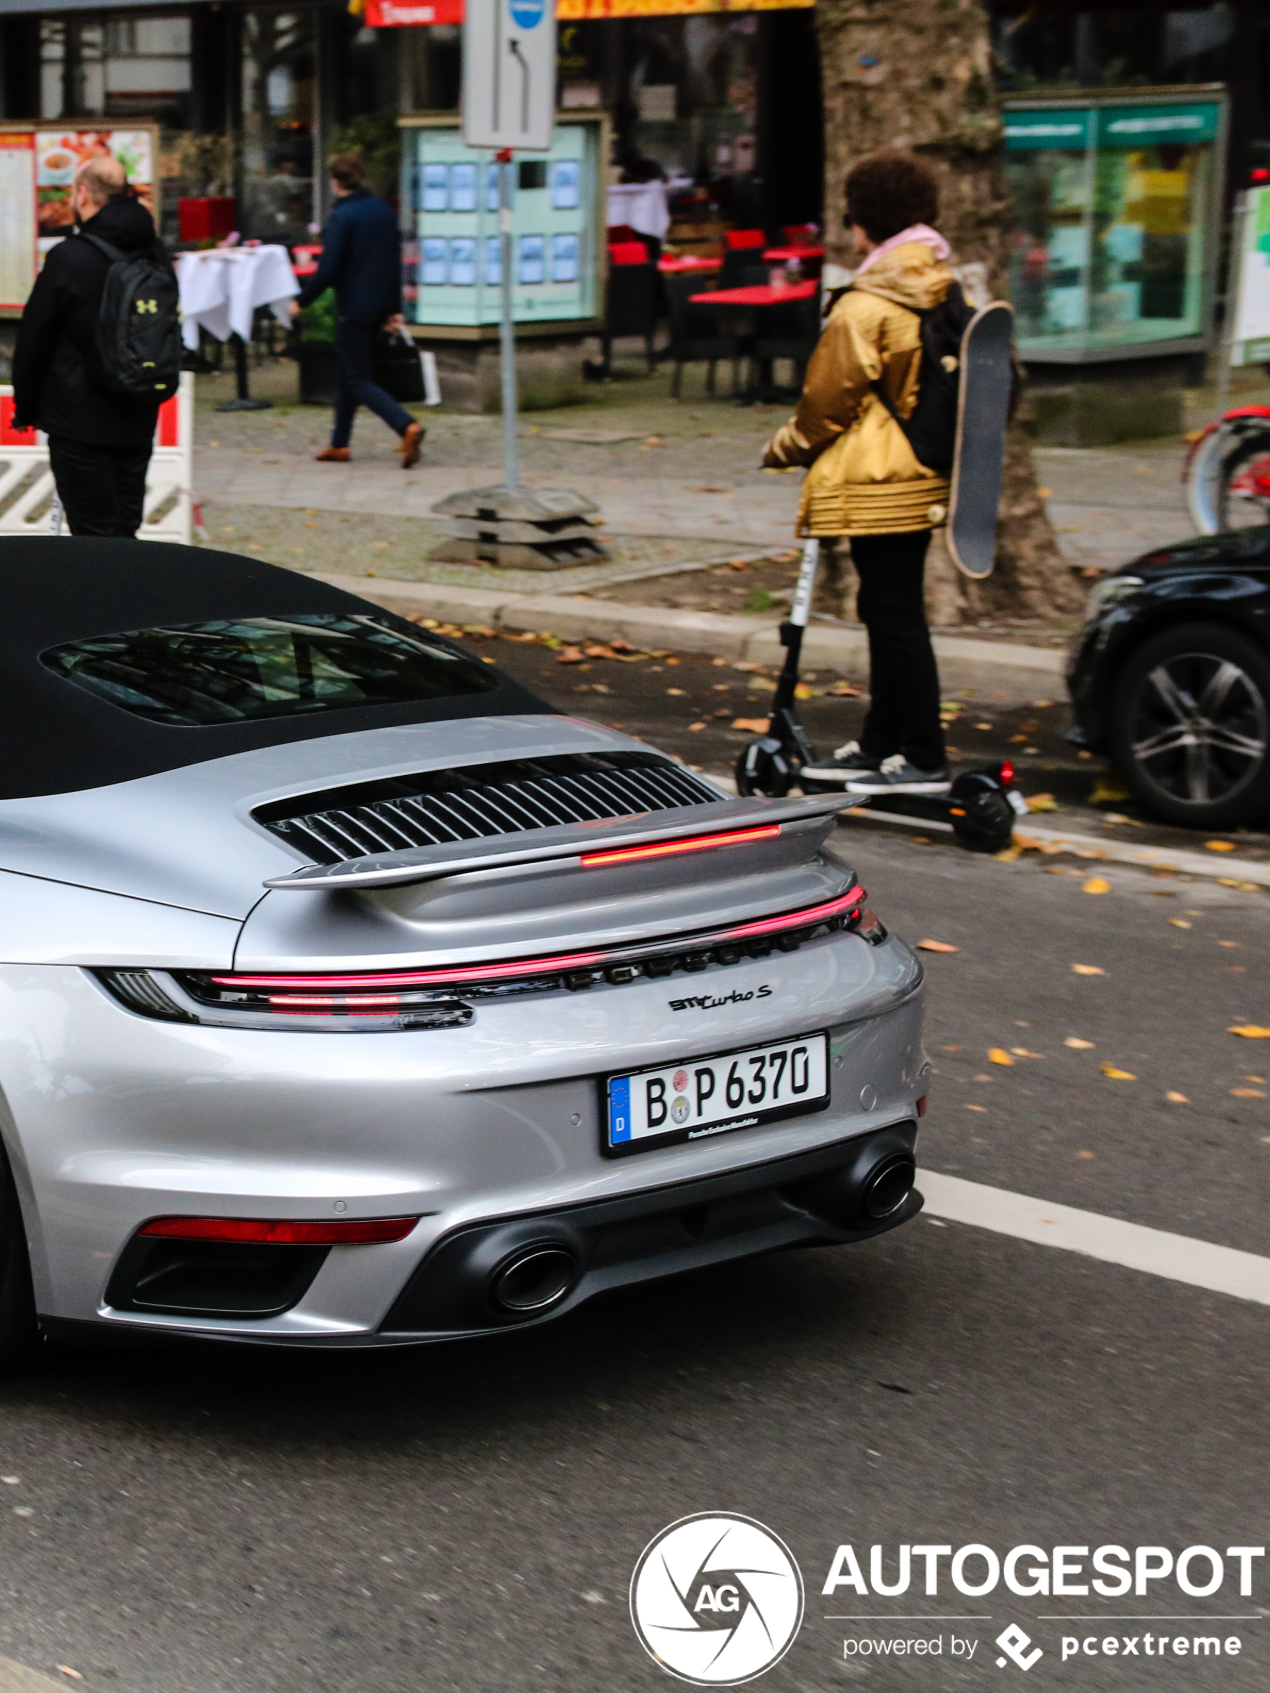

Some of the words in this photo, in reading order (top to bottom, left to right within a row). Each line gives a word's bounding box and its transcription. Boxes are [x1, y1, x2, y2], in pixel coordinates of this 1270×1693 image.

[756, 984, 773, 999] S
[646, 1077, 668, 1129] B
[694, 1067, 716, 1117] P
[725, 1045, 810, 1109] 6370
[616, 1117, 625, 1132] D
